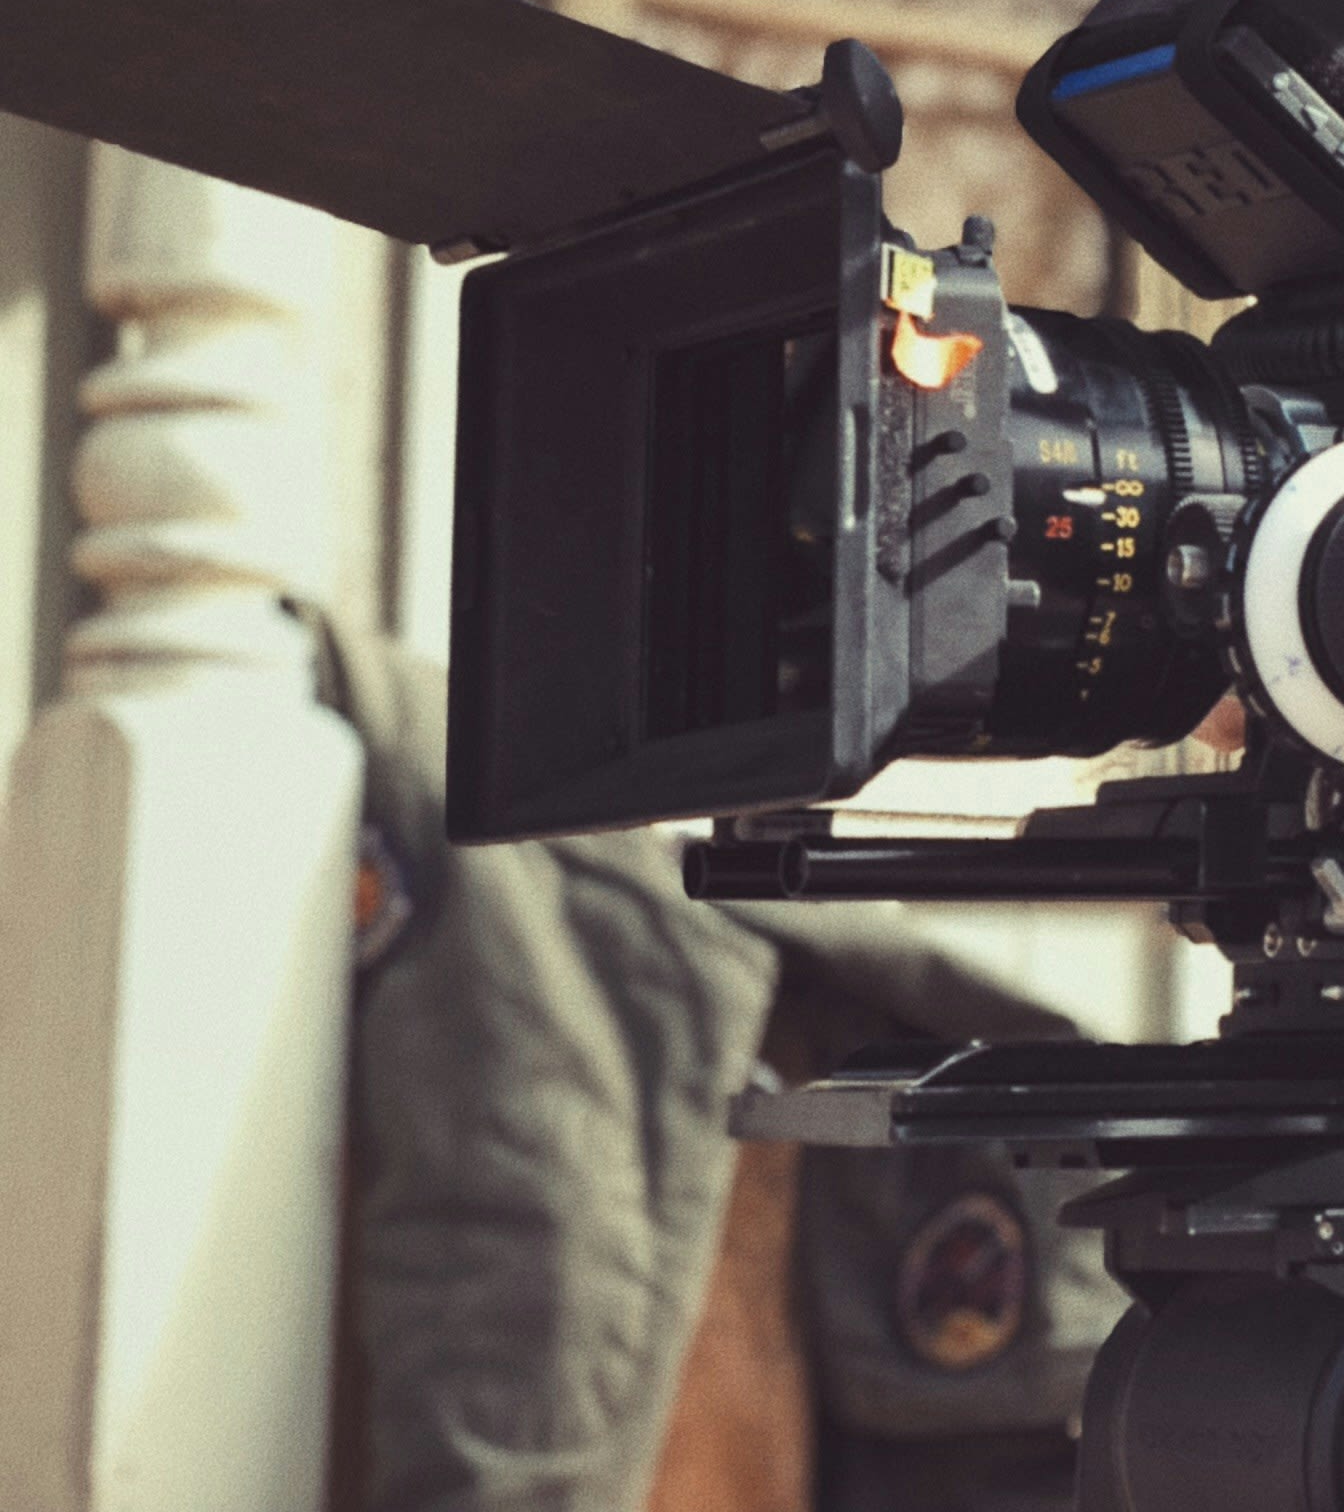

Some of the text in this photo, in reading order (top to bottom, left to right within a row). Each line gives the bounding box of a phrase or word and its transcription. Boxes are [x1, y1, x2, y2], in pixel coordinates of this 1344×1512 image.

[1044, 516, 1073, 540] 25
[1115, 506, 1141, 528] 30
[1116, 537, 1136, 559] 15
[1113, 573, 1132, 592] 10
